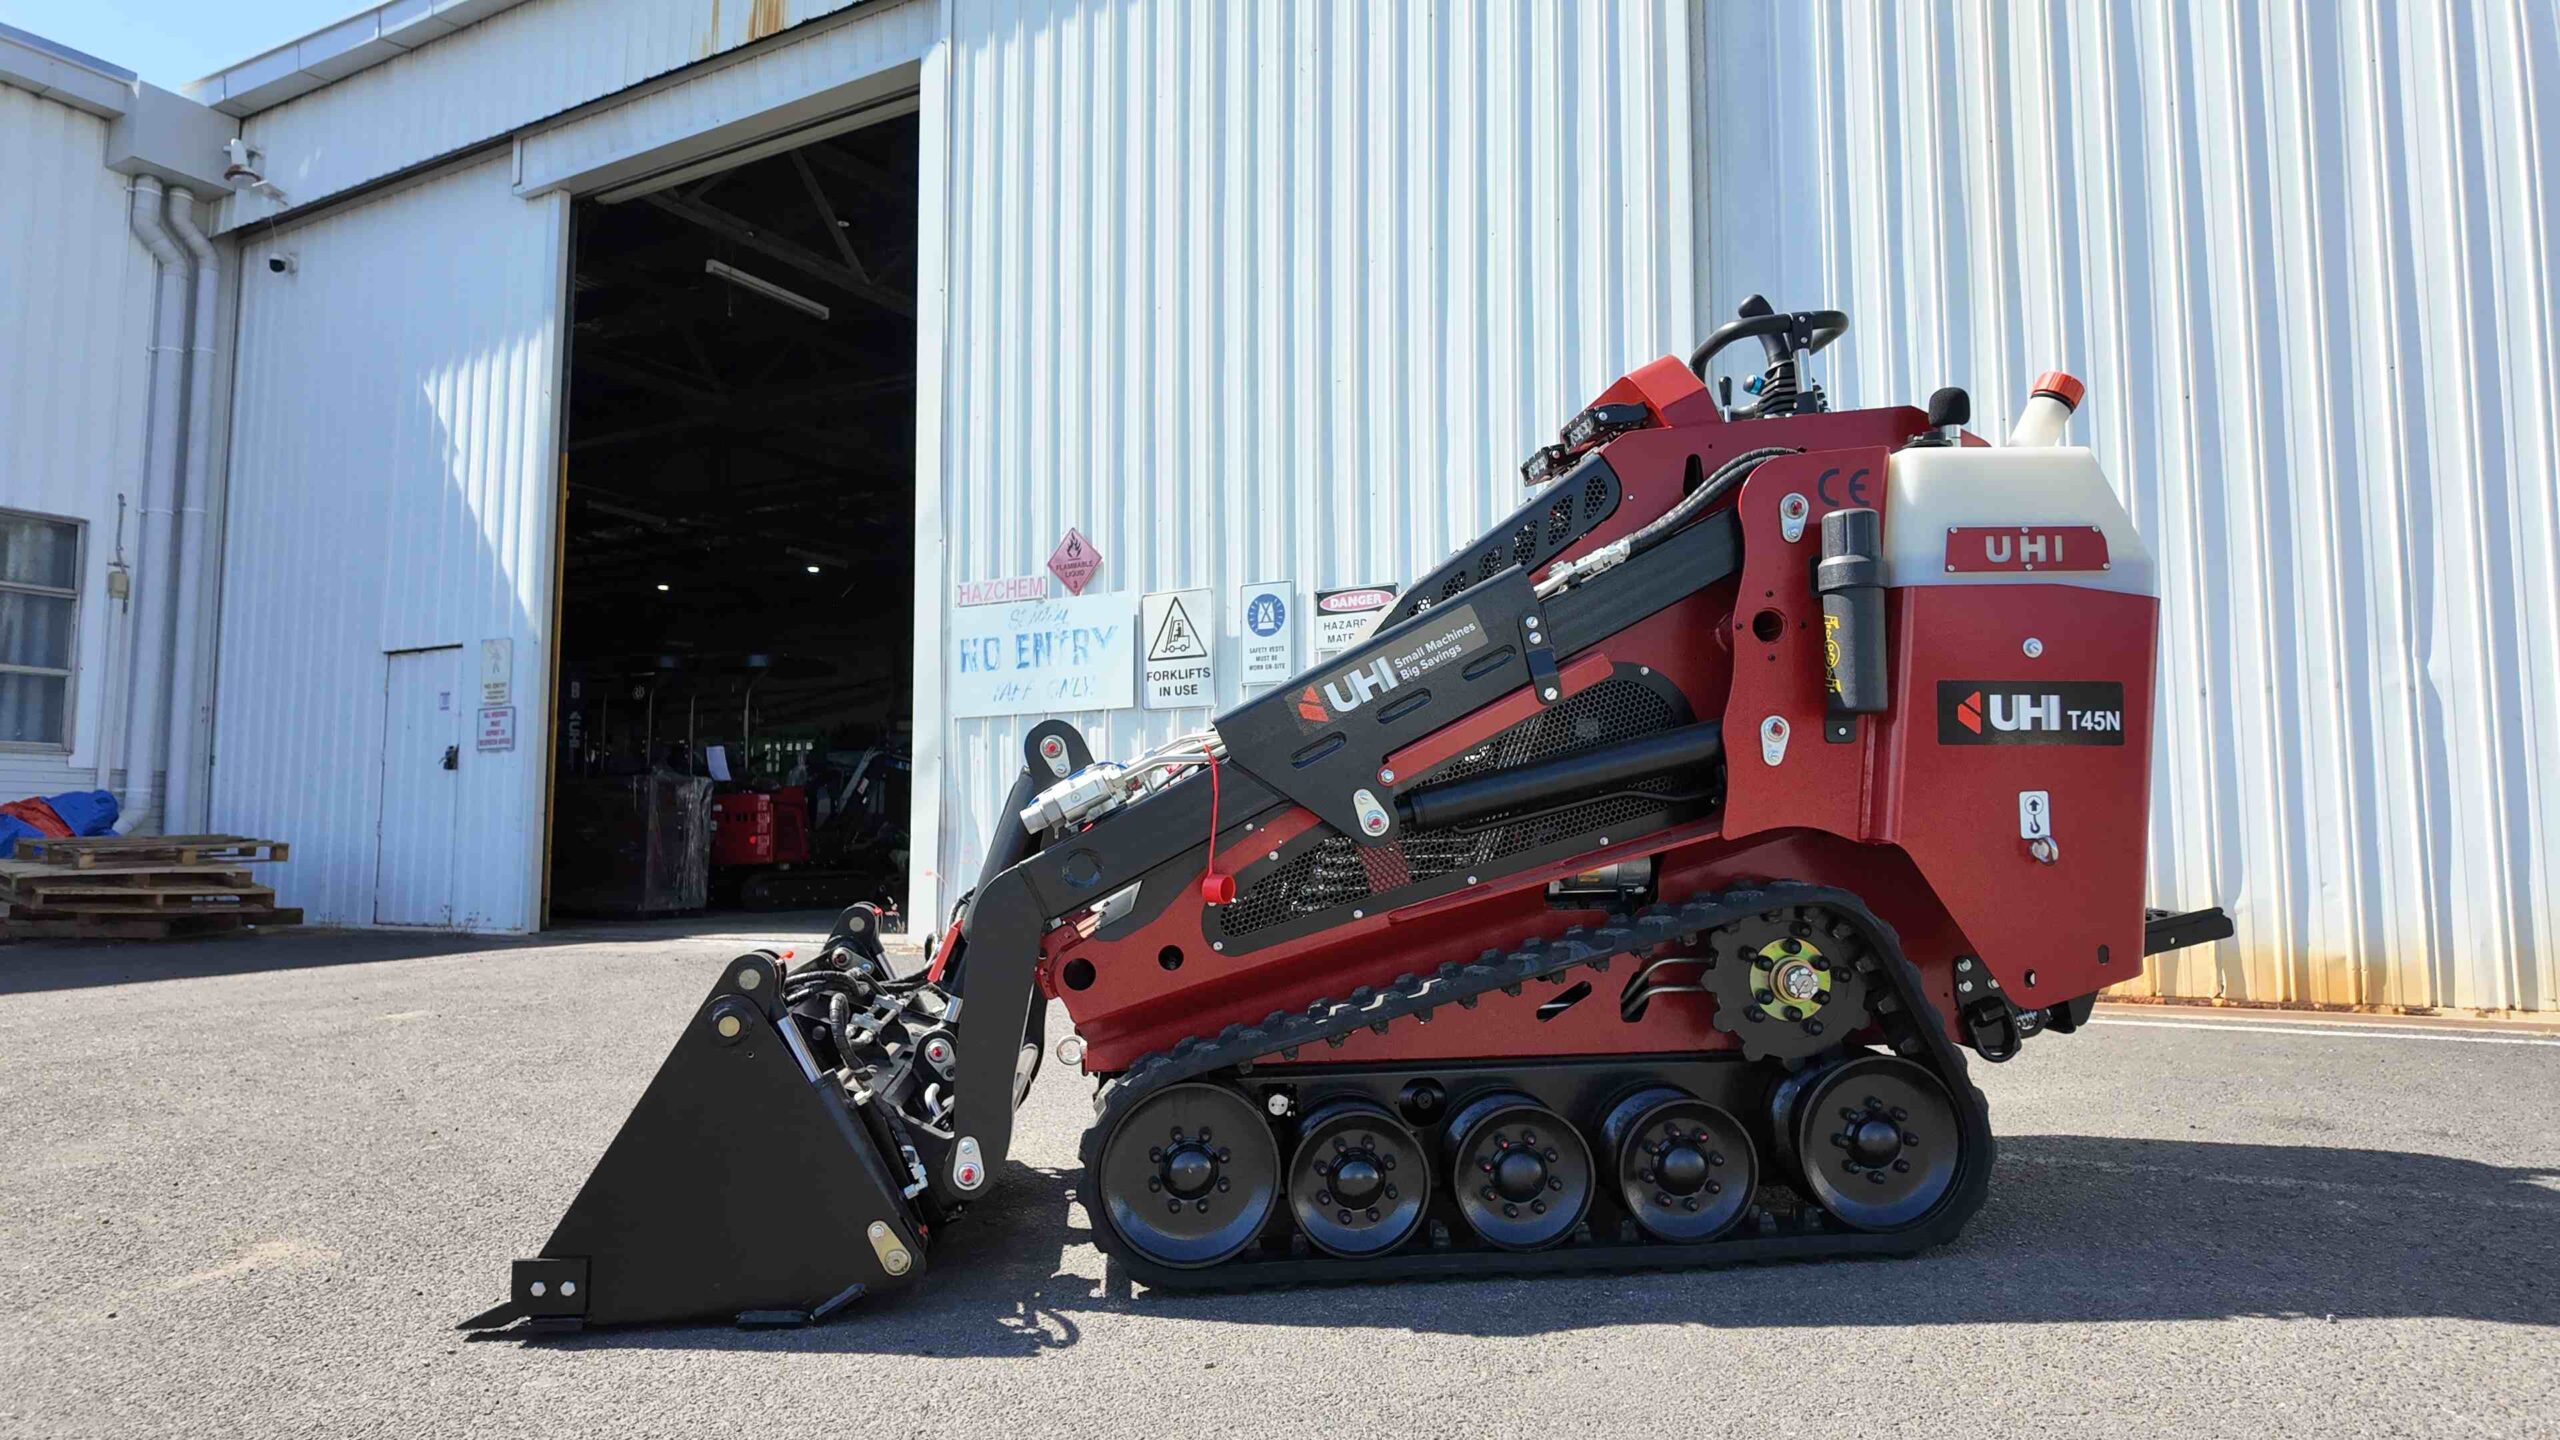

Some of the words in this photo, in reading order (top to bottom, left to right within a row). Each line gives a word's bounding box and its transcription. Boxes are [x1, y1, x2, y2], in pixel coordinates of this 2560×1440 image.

[1818, 468, 1871, 507] CE
[1985, 535, 2063, 563] UHI
[1056, 560, 1093, 570] FLAMMABLE
[1065, 570, 1085, 578] LIQUID
[959, 577, 1043, 604] HAZCHEM
[1330, 592, 1382, 609] DANGER
[960, 636, 1001, 673] NO
[1015, 625, 1118, 670] ENTRY
[1394, 646, 1426, 668] Small
[1424, 622, 1476, 653] Machines
[1146, 667, 1211, 682] FORKLIFTS
[1399, 665, 1420, 681] Big
[1420, 644, 1462, 670] Savings
[1159, 686, 1171, 697] IN
[1175, 684, 1198, 696] USE
[1323, 656, 1399, 712] UHI
[1989, 694, 2061, 731] UHI
[2067, 710, 2121, 731] T45N
